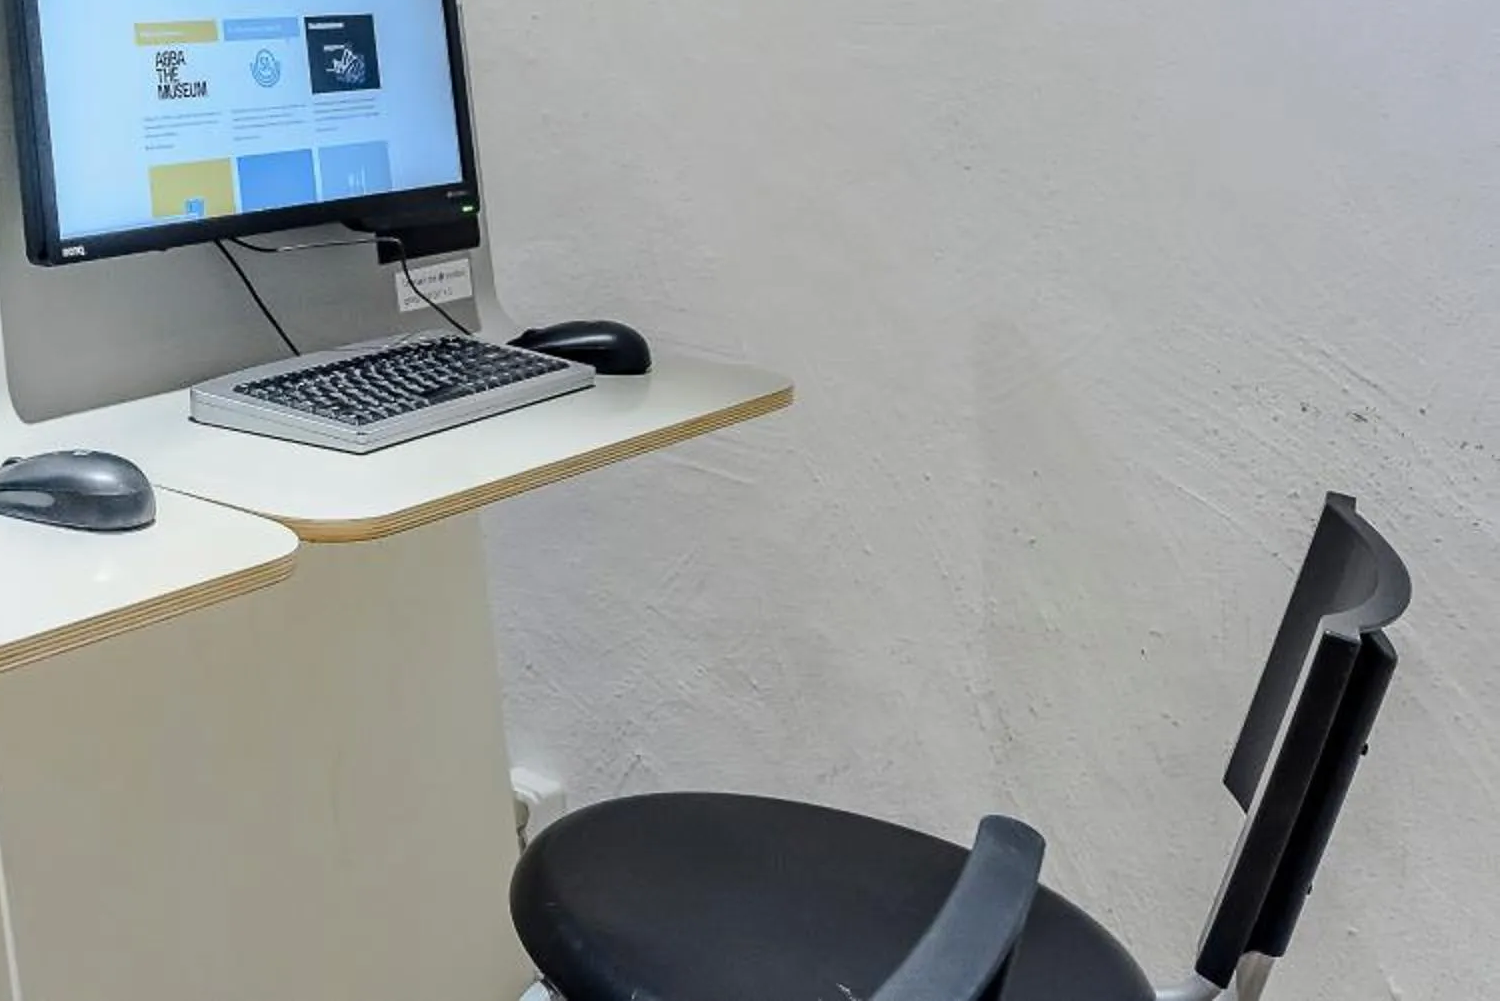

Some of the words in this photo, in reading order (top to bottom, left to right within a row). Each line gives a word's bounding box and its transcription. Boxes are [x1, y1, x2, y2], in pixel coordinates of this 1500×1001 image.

[156, 50, 186, 67] ABBA
[156, 66, 179, 83] THE
[158, 81, 208, 100] MUSEUM
